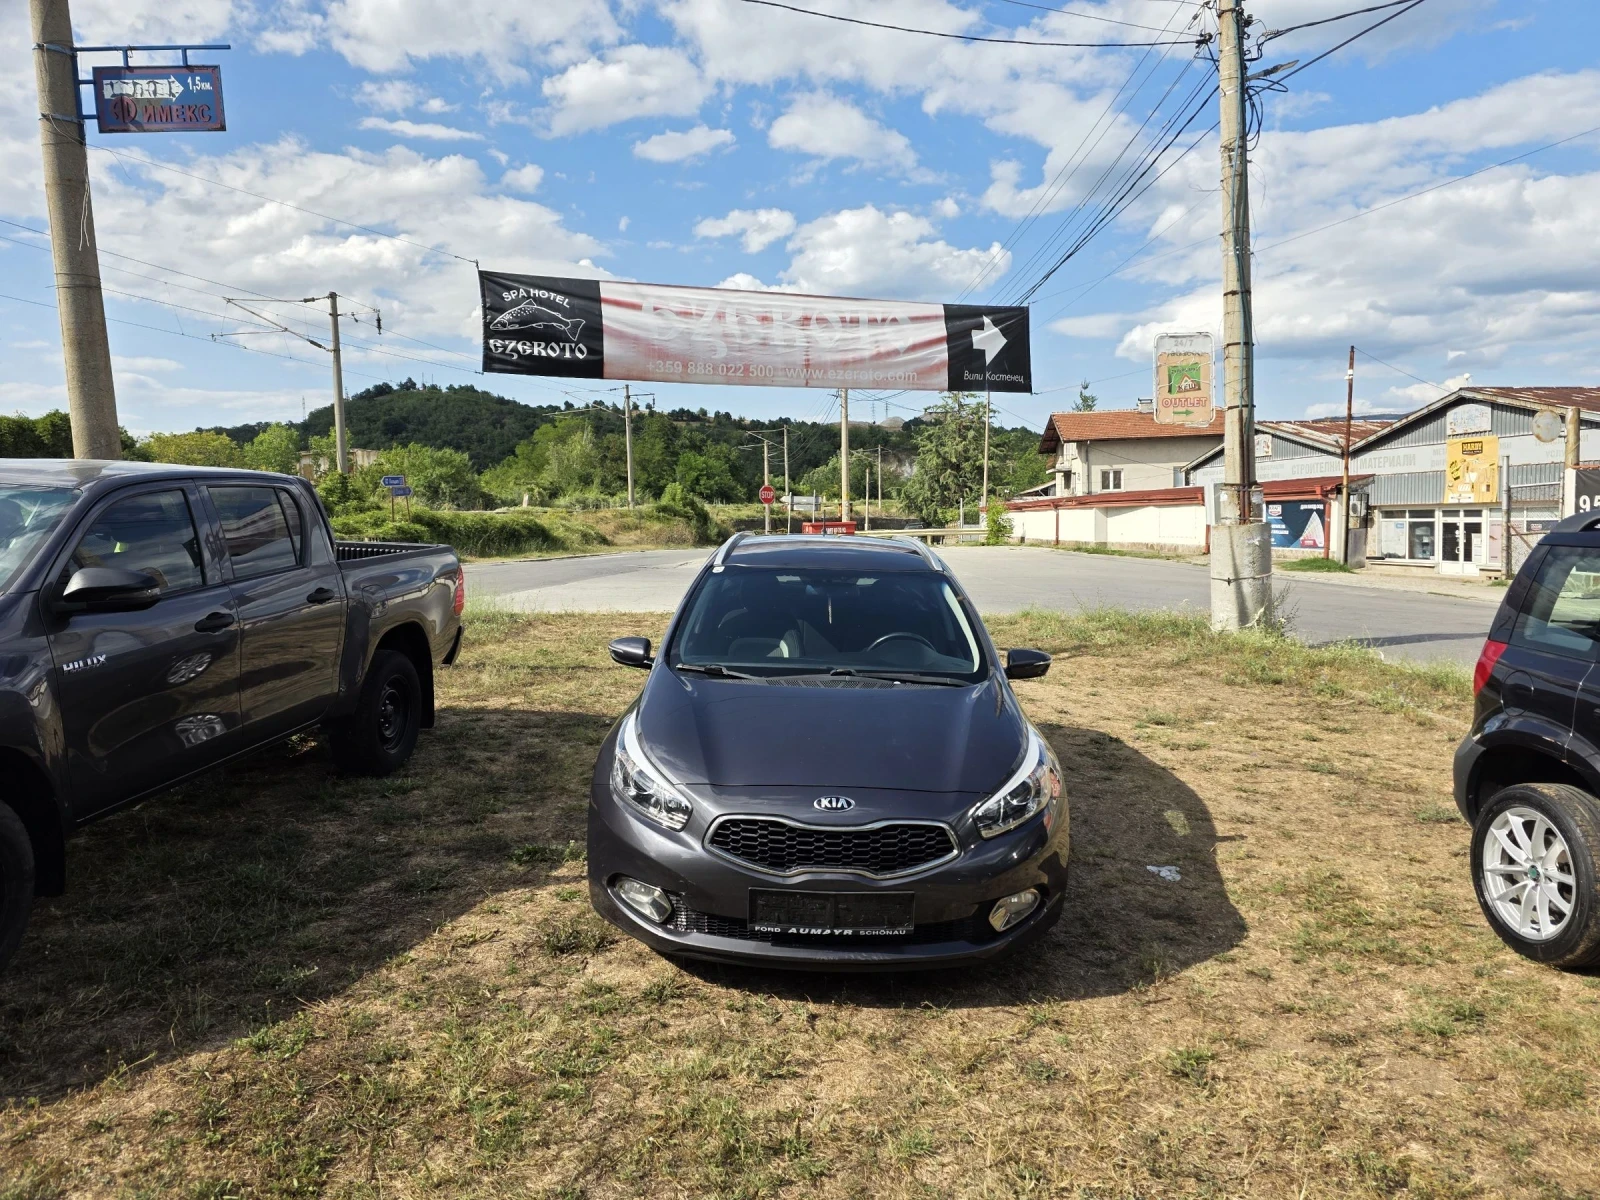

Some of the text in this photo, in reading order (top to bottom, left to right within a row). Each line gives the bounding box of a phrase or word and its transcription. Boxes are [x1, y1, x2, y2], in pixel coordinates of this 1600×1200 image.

[502, 288, 570, 308] SPA HOTEL
[647, 360, 683, 375] +359
[688, 361, 714, 376] 888
[718, 363, 744, 378] 022
[748, 365, 775, 379] 500
[986, 371, 1024, 384] Костенец
[1162, 397, 1208, 408] OUTLET
[1360, 454, 1416, 469] МАТЕРИАЛИ
[761, 491, 774, 499] STOP
[820, 797, 849, 809] KIA
[788, 927, 854, 936] AUMAYR
